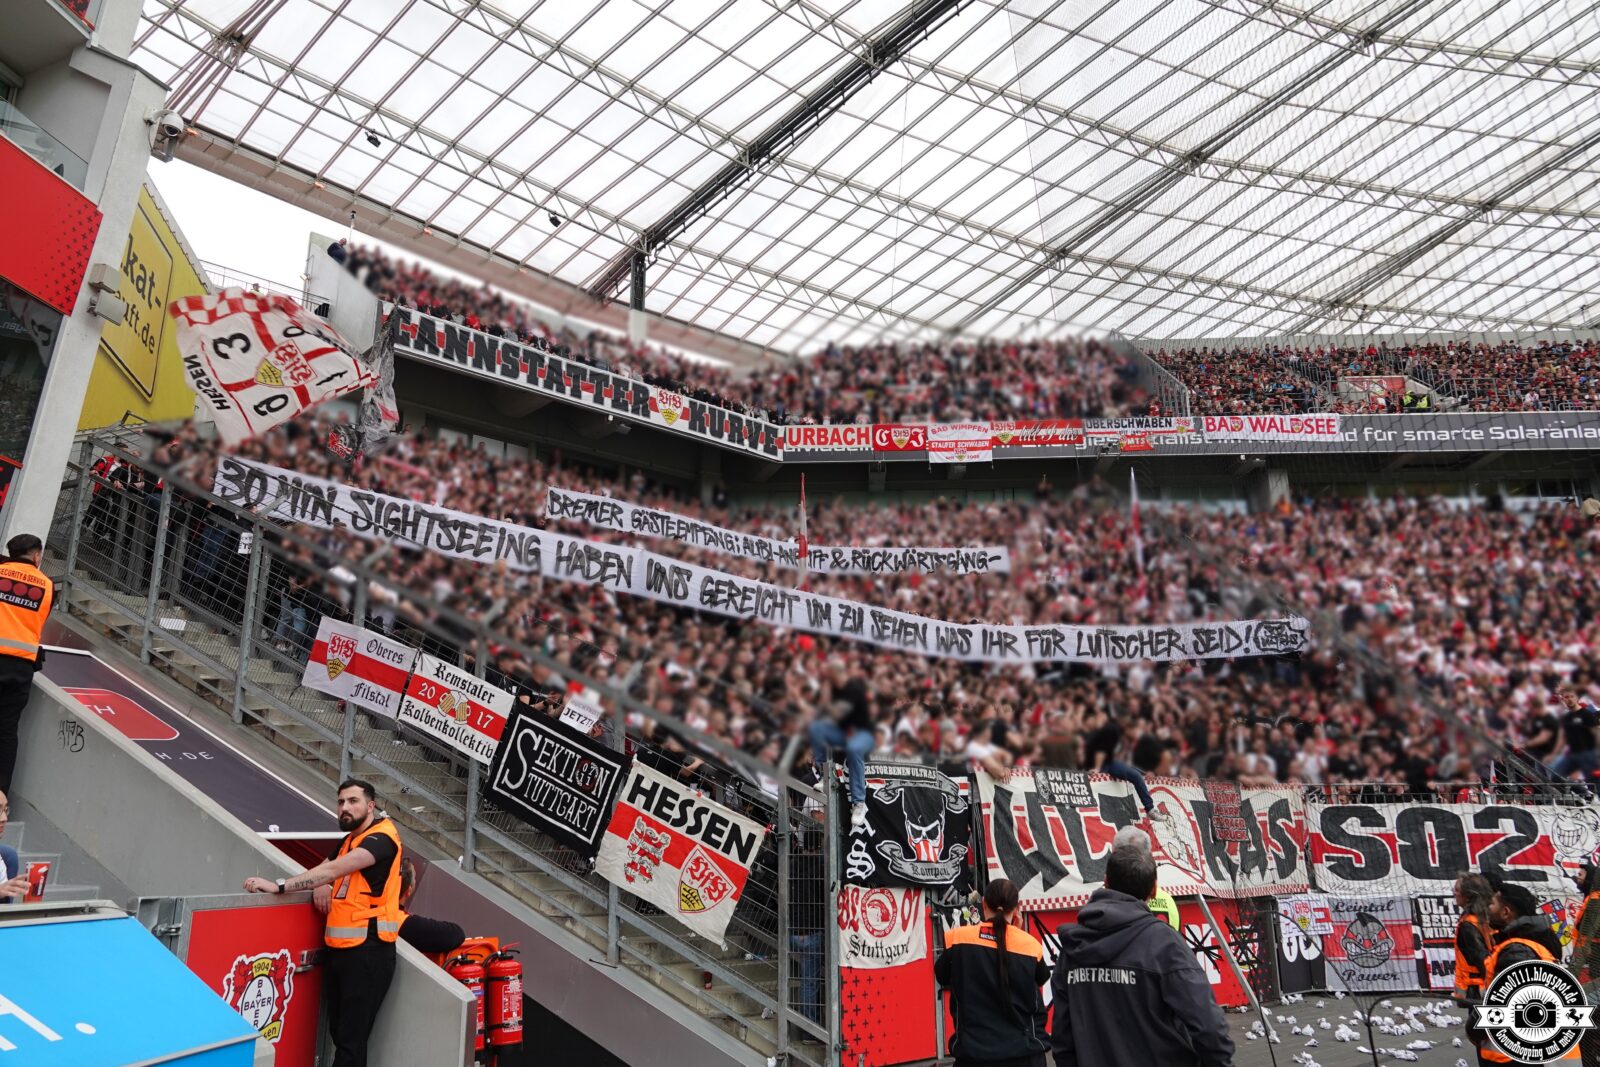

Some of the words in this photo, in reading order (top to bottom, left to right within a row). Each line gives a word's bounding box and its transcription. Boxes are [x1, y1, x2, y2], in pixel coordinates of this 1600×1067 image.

[688, 400, 779, 457] KURVE
[931, 425, 948, 435] BAD
[950, 424, 989, 434] WIMPFEN
[1086, 417, 1172, 429] OBERSCHWABEN
[1204, 416, 1243, 432] BAD
[1247, 416, 1337, 434] WALDSEE
[788, 426, 870, 447] URBACH
[1363, 427, 1397, 441] für
[1403, 427, 1485, 441] smarte
[1489, 424, 1600, 441] Solaranla
[548, 489, 624, 528] BREMER
[829, 547, 850, 569] &
[220, 459, 268, 506] 30
[350, 490, 541, 567] SIGHTSEEING
[555, 540, 634, 588] HABEN
[645, 558, 693, 601] UNS
[700, 575, 800, 624] GEREICHT
[805, 598, 832, 631] UM
[839, 603, 864, 636] ZU
[870, 609, 928, 650] SEHEN
[935, 625, 973, 656] WAS
[981, 628, 1021, 657] IHR
[1024, 628, 1068, 658] FÜR
[1076, 627, 1188, 660] LUTSCHER
[1192, 623, 1253, 656] SEID!
[0, 567, 23, 580] ECURITY
[0, 592, 38, 609] ECURITAS
[367, 638, 404, 664] Oberes
[432, 661, 495, 705] Remstaler
[350, 681, 392, 709] Filstal
[418, 682, 436, 700] 20
[475, 710, 495, 730] 17
[562, 707, 595, 728] JETZT!
[402, 699, 495, 759] Kolbenkollektiv
[864, 764, 911, 777] ERSTORBENEN
[1047, 770, 1063, 781] DU
[1064, 771, 1085, 784] BIST
[1050, 781, 1090, 796] IMMER
[1054, 793, 1069, 804] BEI
[627, 773, 756, 865] HESSEN
[1332, 899, 1395, 913] Leintal
[1417, 897, 1456, 915] ULT
[1420, 914, 1459, 927] BEDE
[1422, 927, 1457, 939] WIDE
[846, 934, 911, 965] Stuttgart
[253, 963, 270, 973] 1904
[1341, 968, 1402, 984] Power
[243, 996, 272, 1012] BAYER
